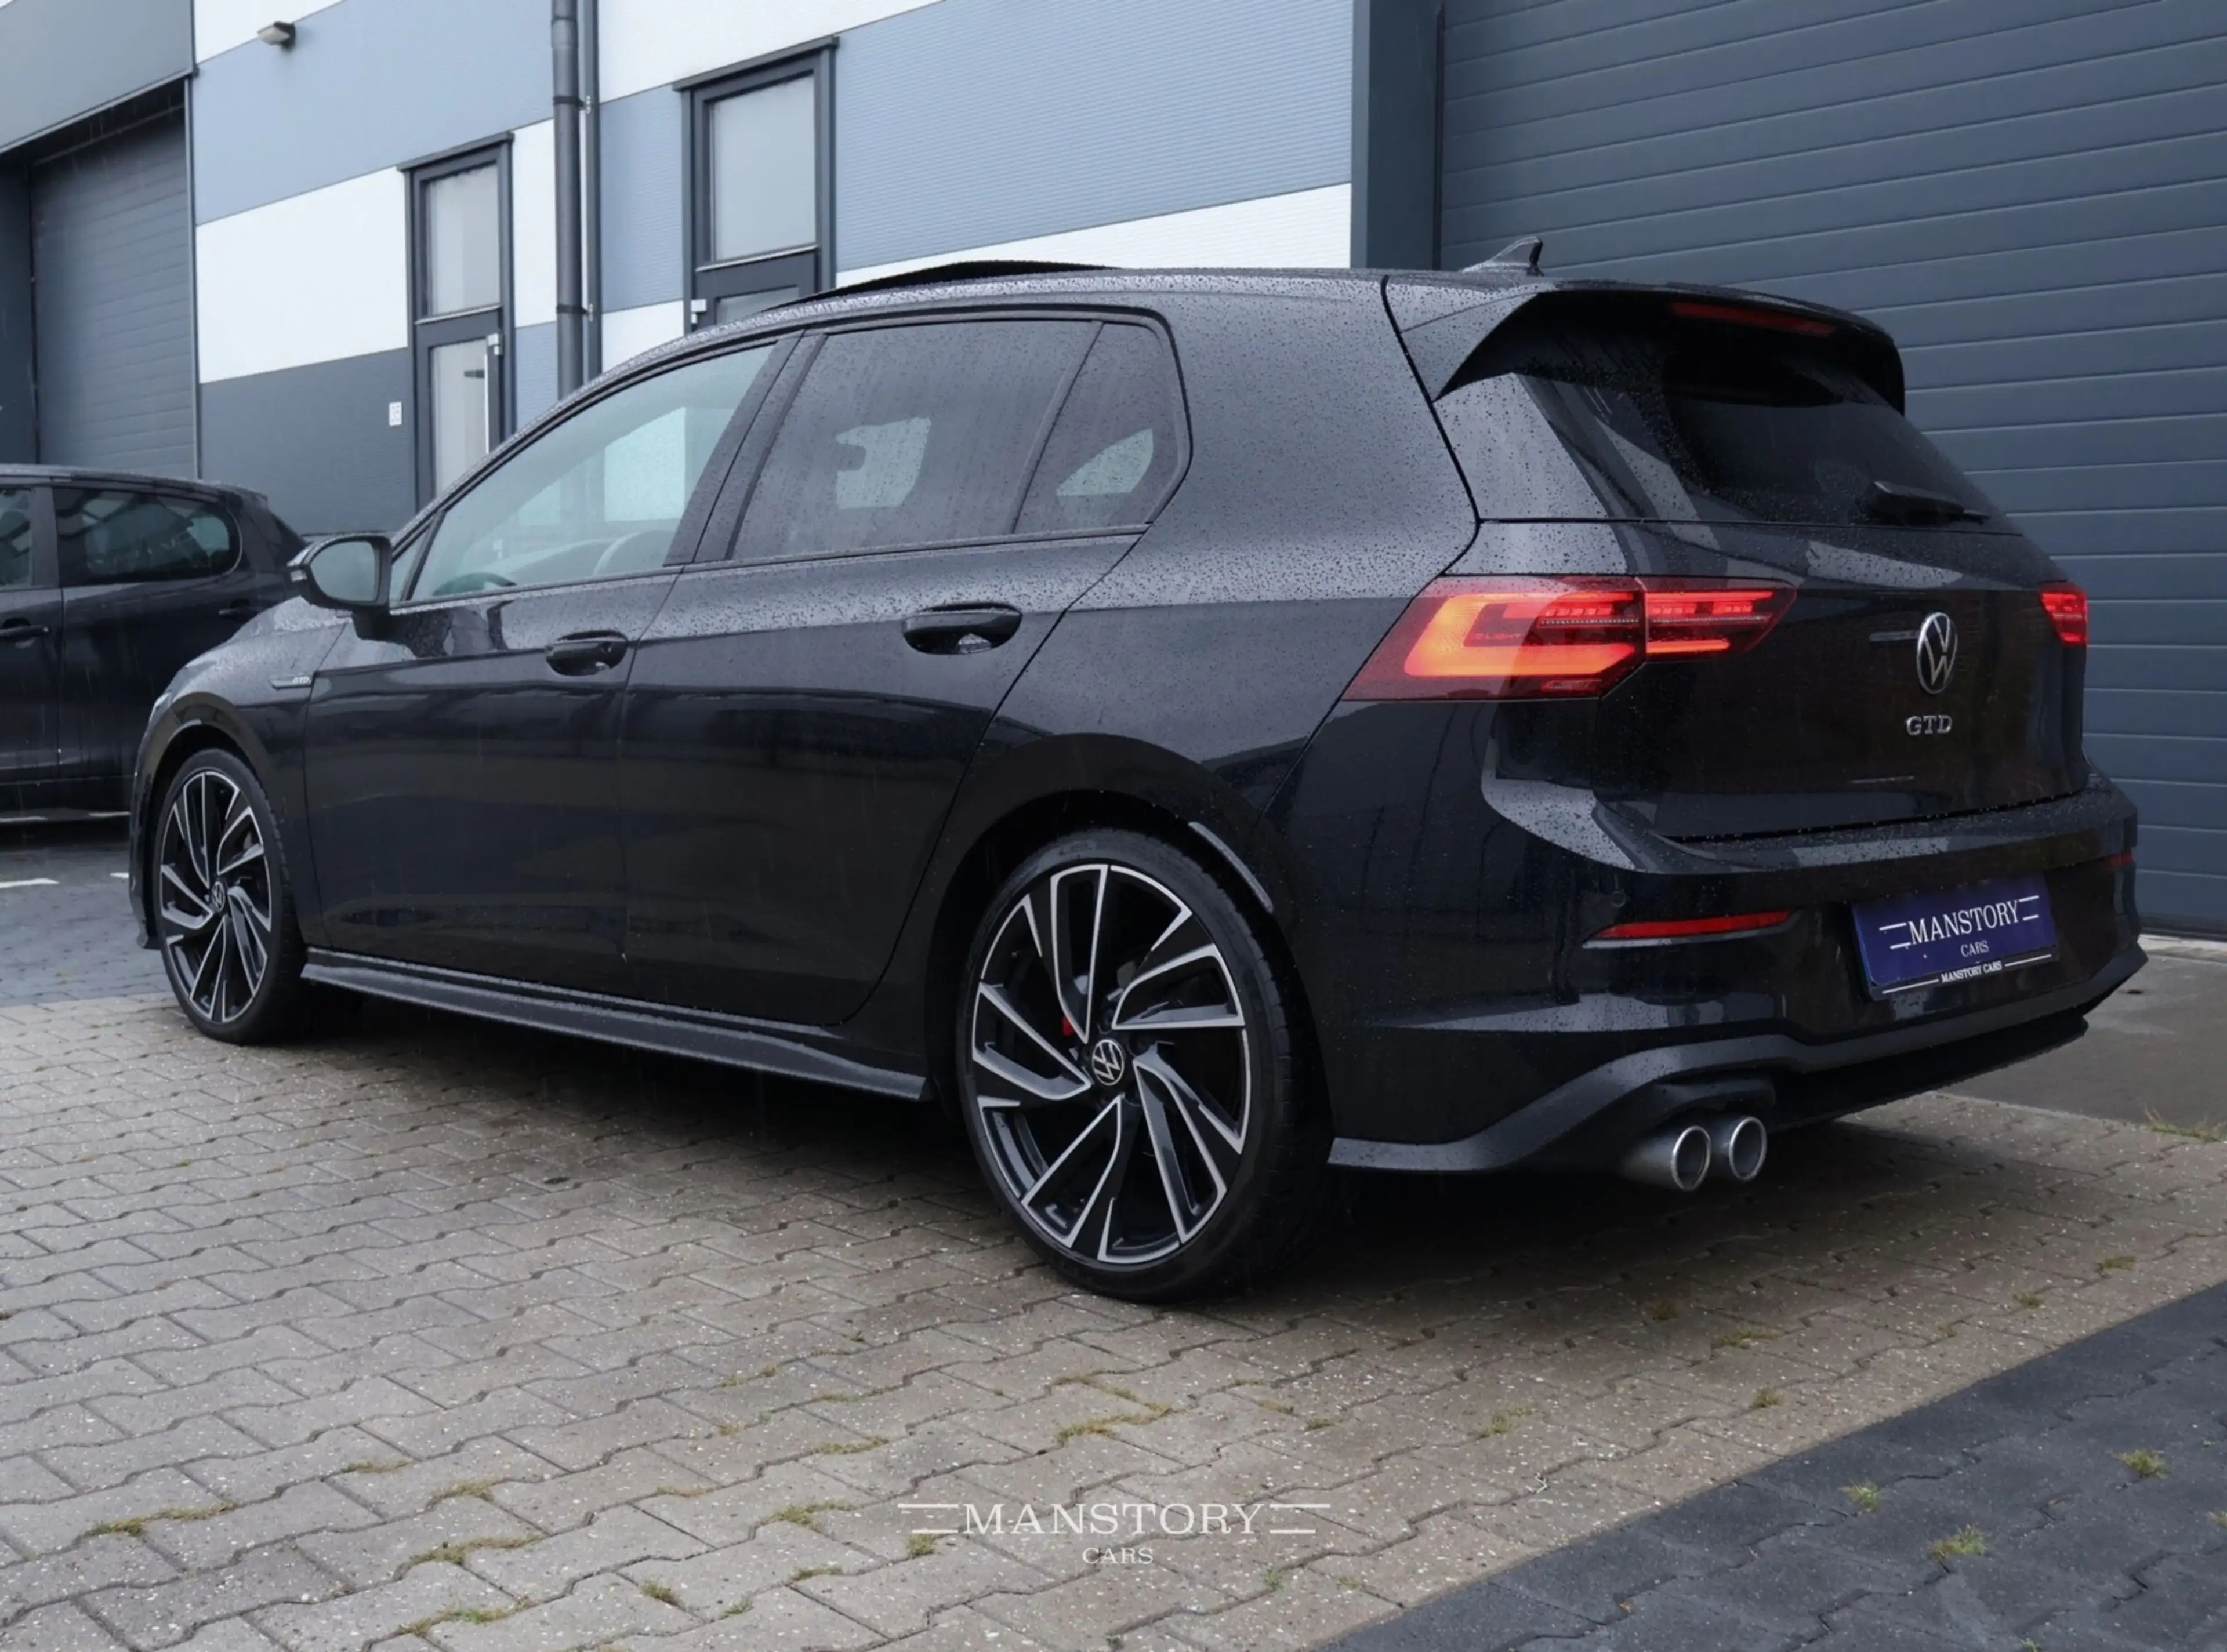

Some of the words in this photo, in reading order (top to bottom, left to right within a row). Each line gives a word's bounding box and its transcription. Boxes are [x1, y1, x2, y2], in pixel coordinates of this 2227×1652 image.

[1905, 714, 1953, 736] GTD
[1907, 899, 2019, 945] MANSTORY
[1960, 940, 1989, 958] CARS
[1941, 965, 1982, 983] MANSTORY
[1983, 960, 2003, 974] CARS
